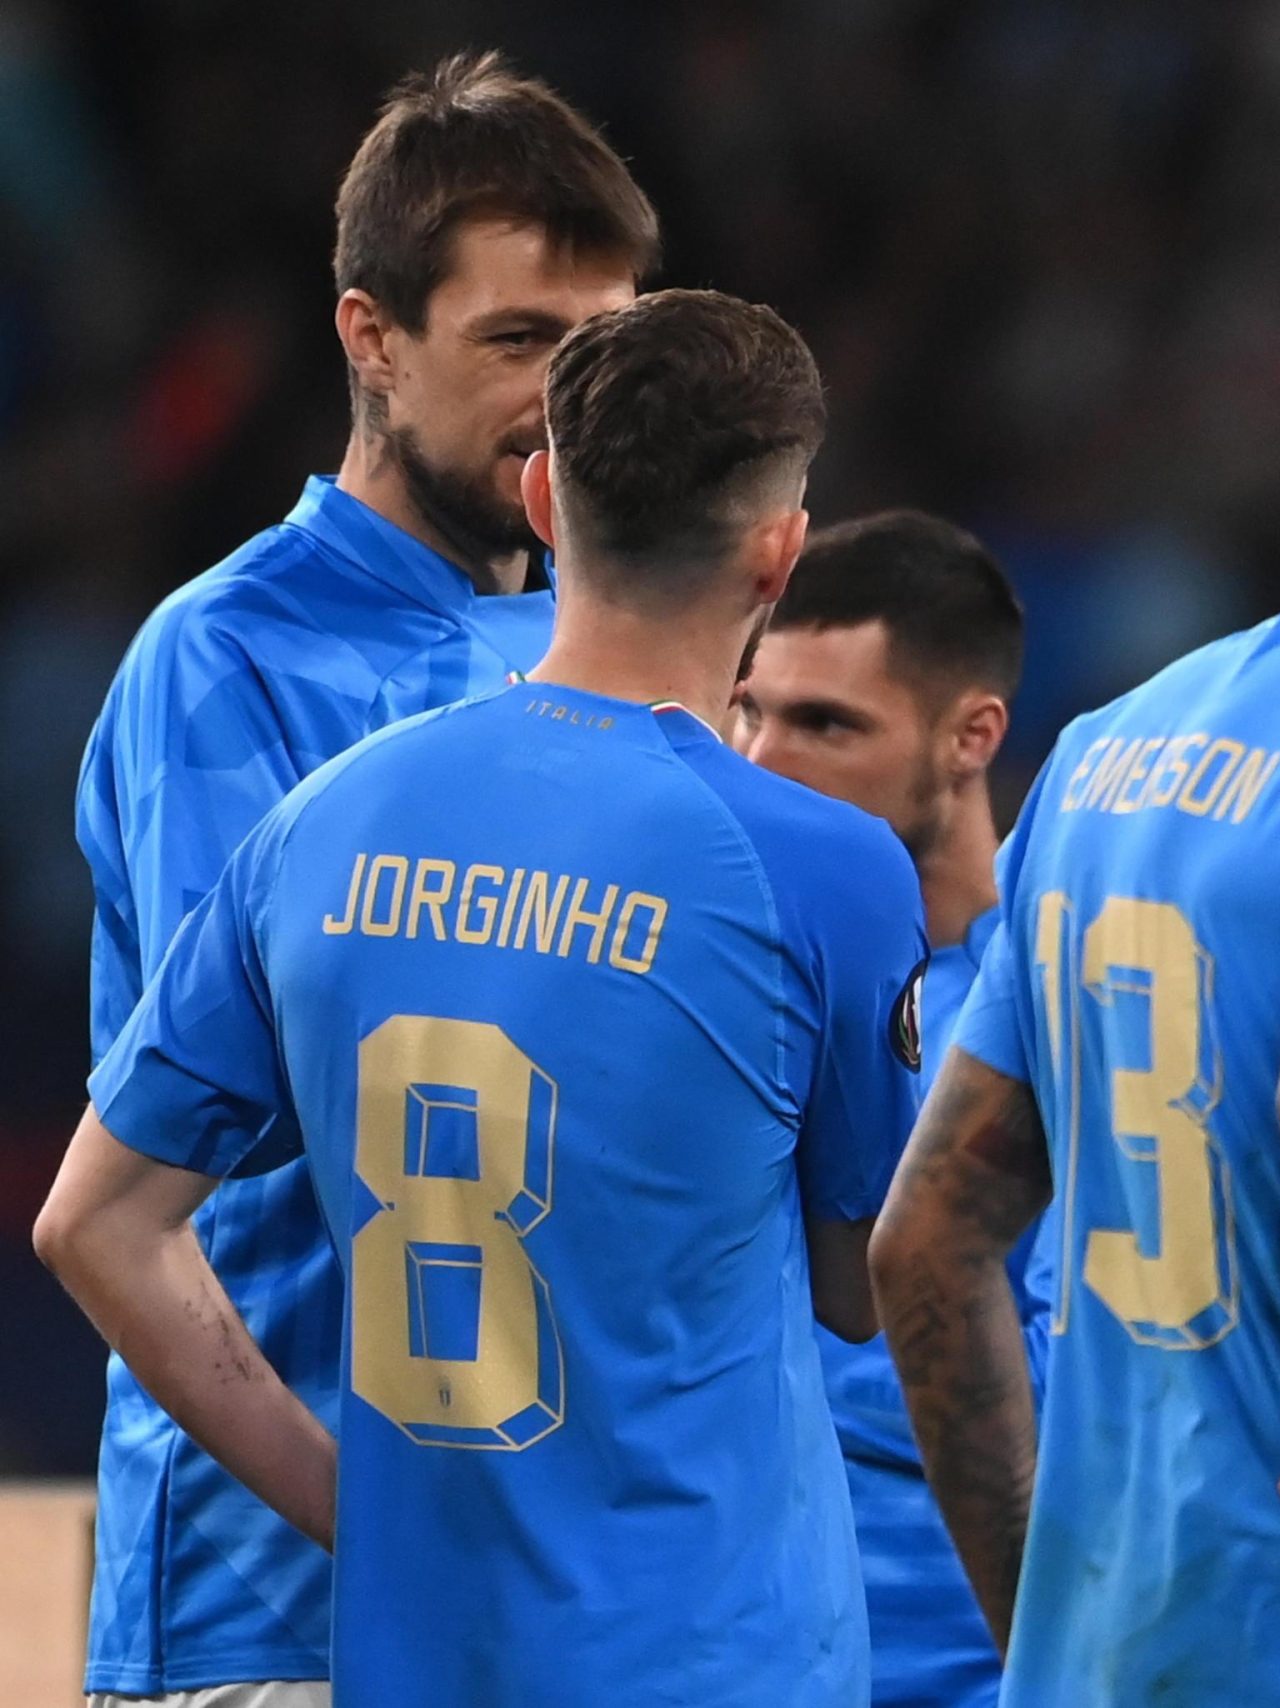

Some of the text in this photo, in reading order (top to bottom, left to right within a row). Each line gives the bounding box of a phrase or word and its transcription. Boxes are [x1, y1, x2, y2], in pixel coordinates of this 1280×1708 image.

[526, 700, 615, 730] ITALIA
[322, 852, 669, 974] JORGINHO
[350, 1013, 565, 1452] 8
